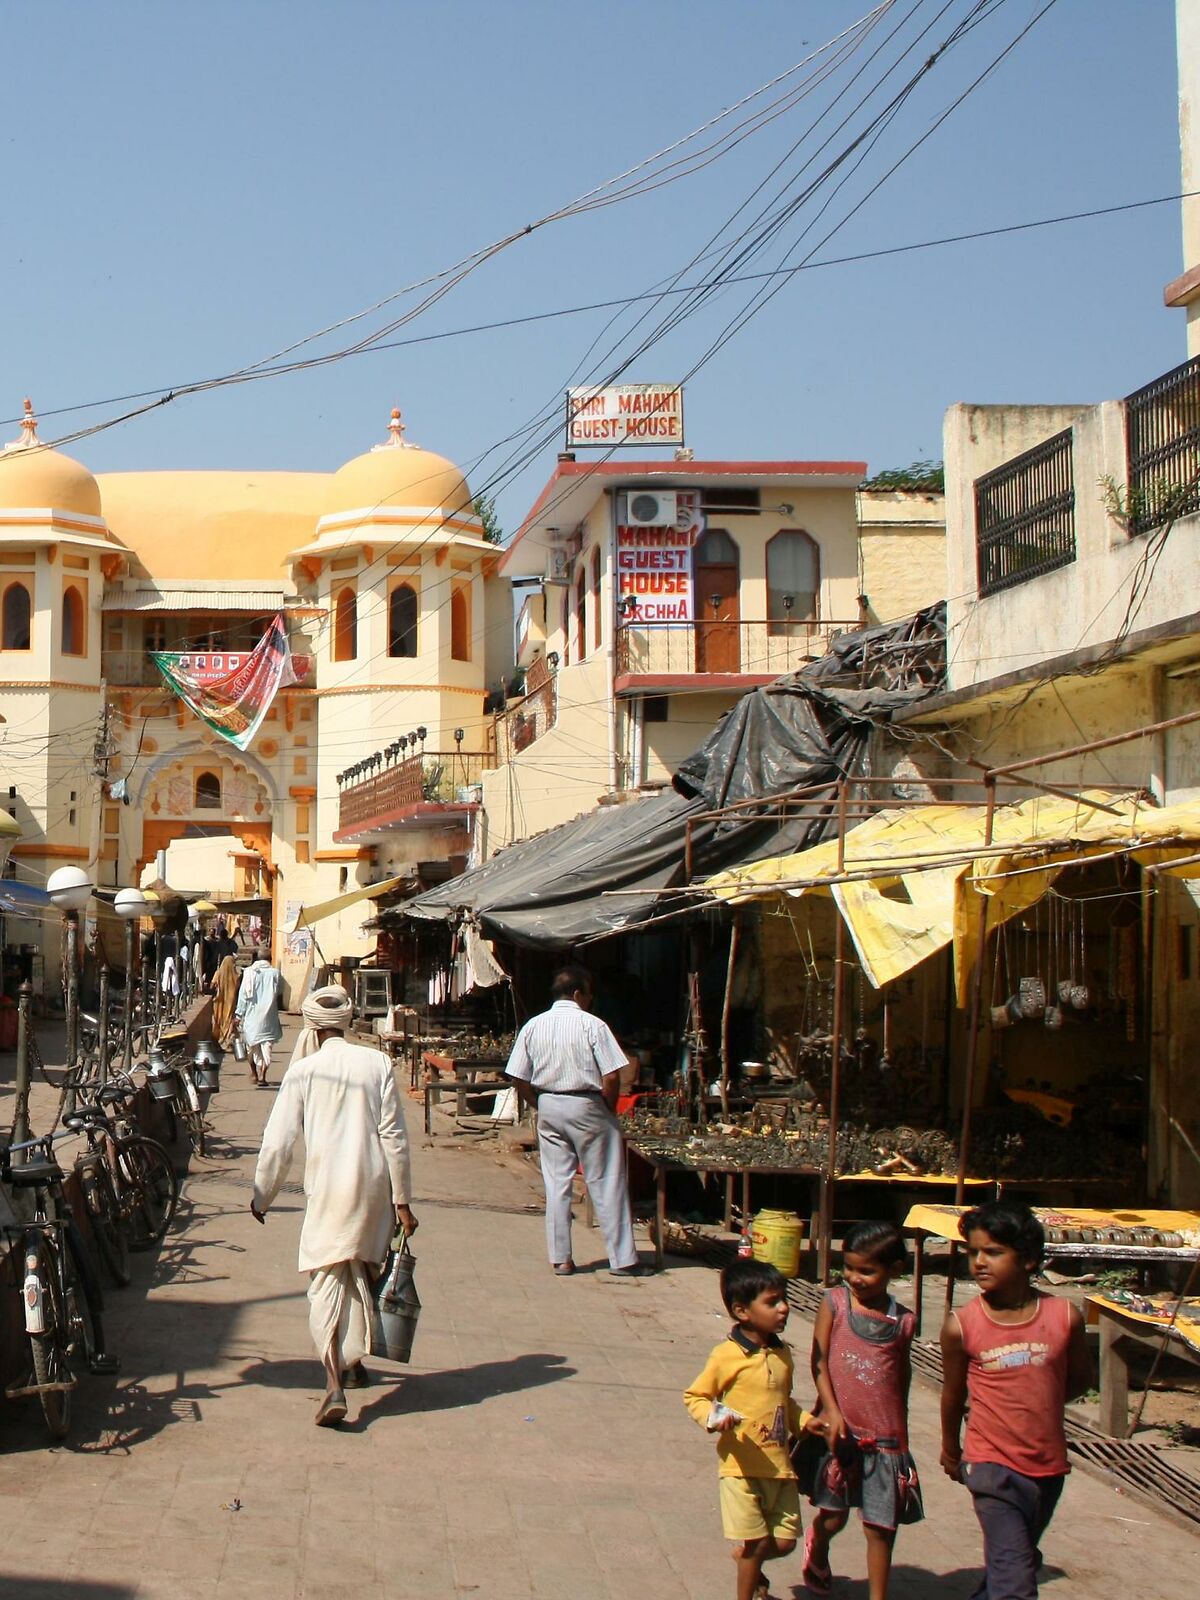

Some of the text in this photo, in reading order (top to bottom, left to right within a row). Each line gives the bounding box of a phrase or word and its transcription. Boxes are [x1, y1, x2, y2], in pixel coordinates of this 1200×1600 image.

[571, 392, 679, 416] SHRI MAHANT
[618, 550, 687, 569] GUEST
[619, 572, 689, 594] HOUSE
